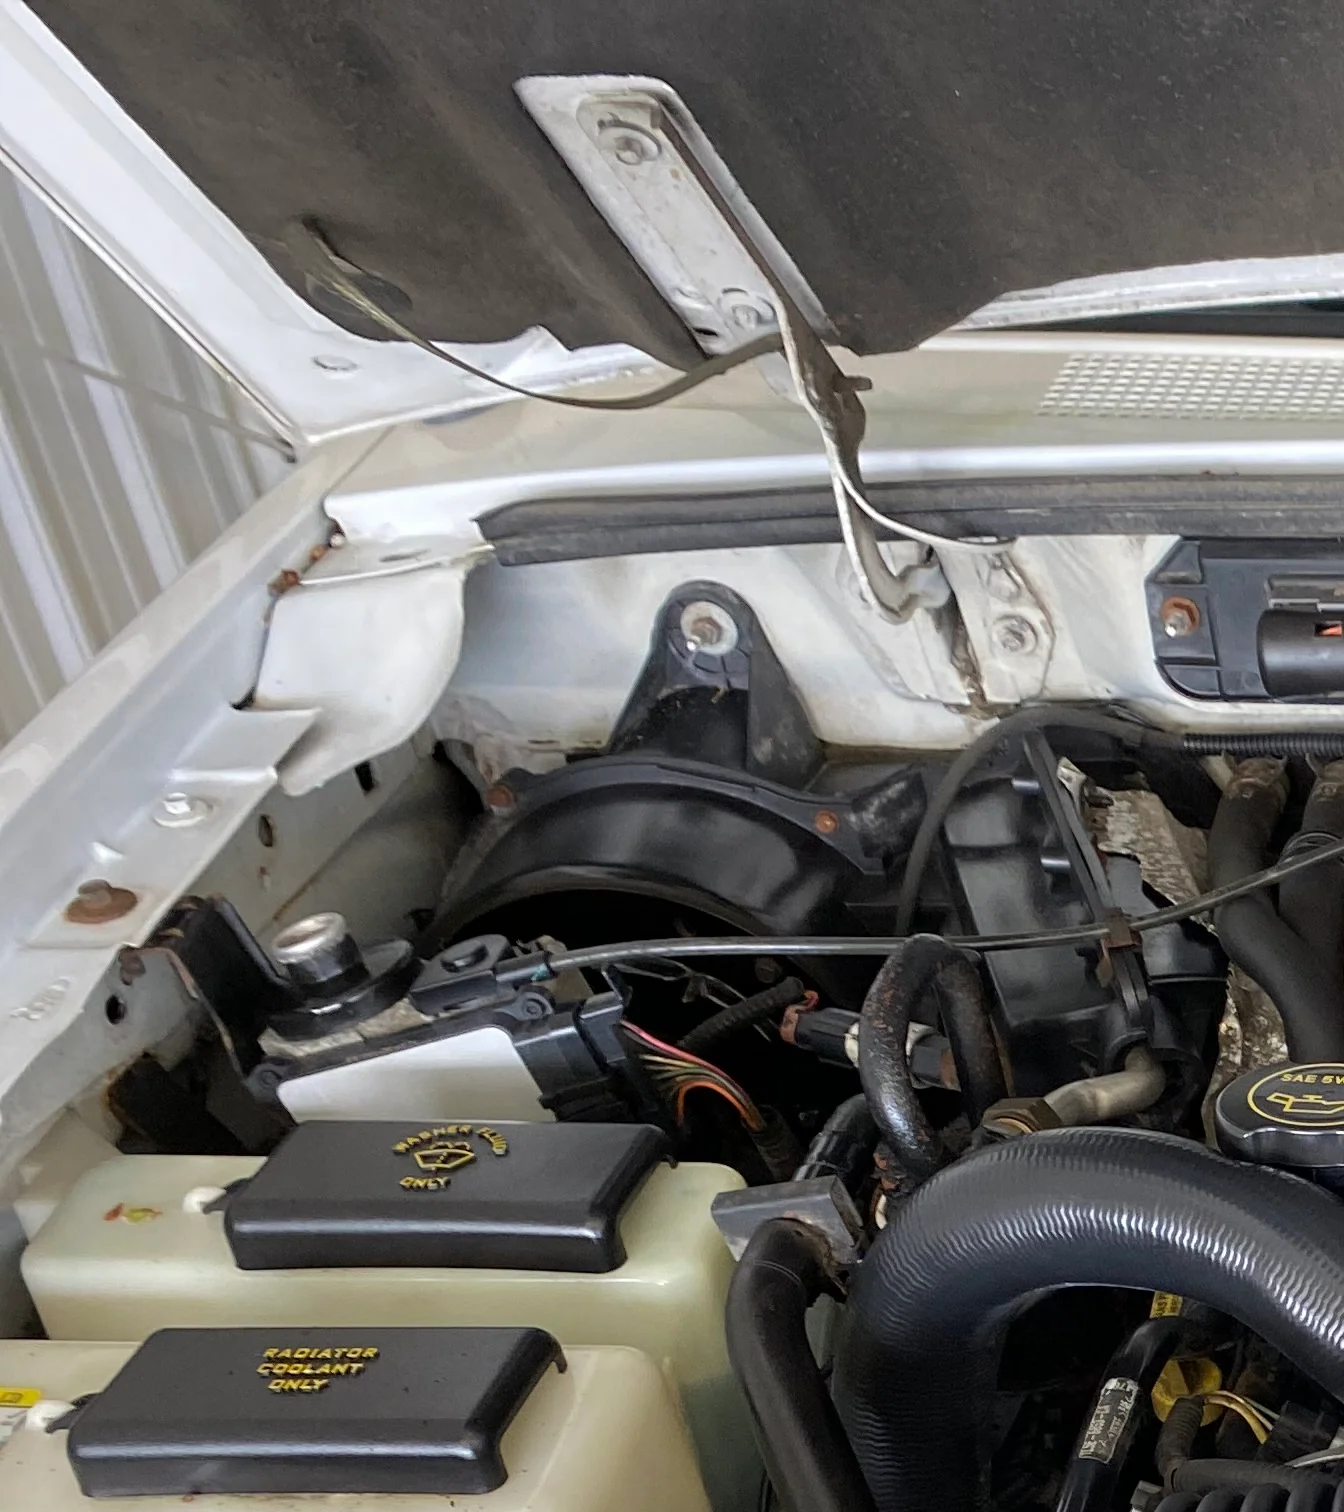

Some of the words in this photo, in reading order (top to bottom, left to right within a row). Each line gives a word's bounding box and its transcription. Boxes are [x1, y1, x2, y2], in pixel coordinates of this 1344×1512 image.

[1280, 1073, 1318, 1084] SAE
[400, 1177, 450, 1190] ONLY
[263, 1348, 379, 1359] RADIATOR
[256, 1363, 365, 1376] COOLANT
[268, 1379, 329, 1393] ONLY
